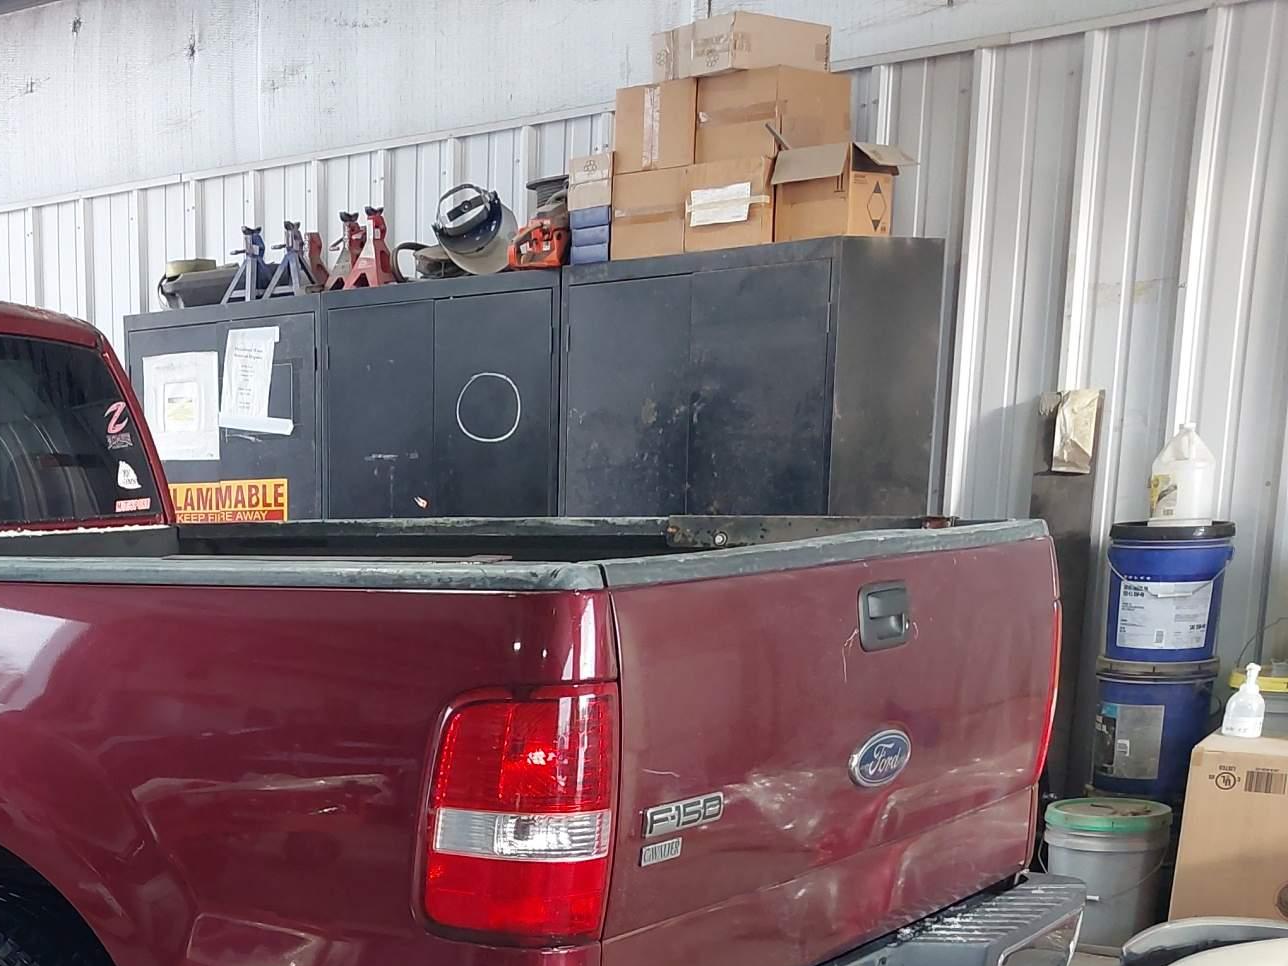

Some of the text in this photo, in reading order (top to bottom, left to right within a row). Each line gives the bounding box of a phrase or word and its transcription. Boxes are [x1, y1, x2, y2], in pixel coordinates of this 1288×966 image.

[176, 511, 268, 522] KEEP FIRE AWAY
[869, 743, 902, 775] Ford
[649, 796, 722, 834] F-150
